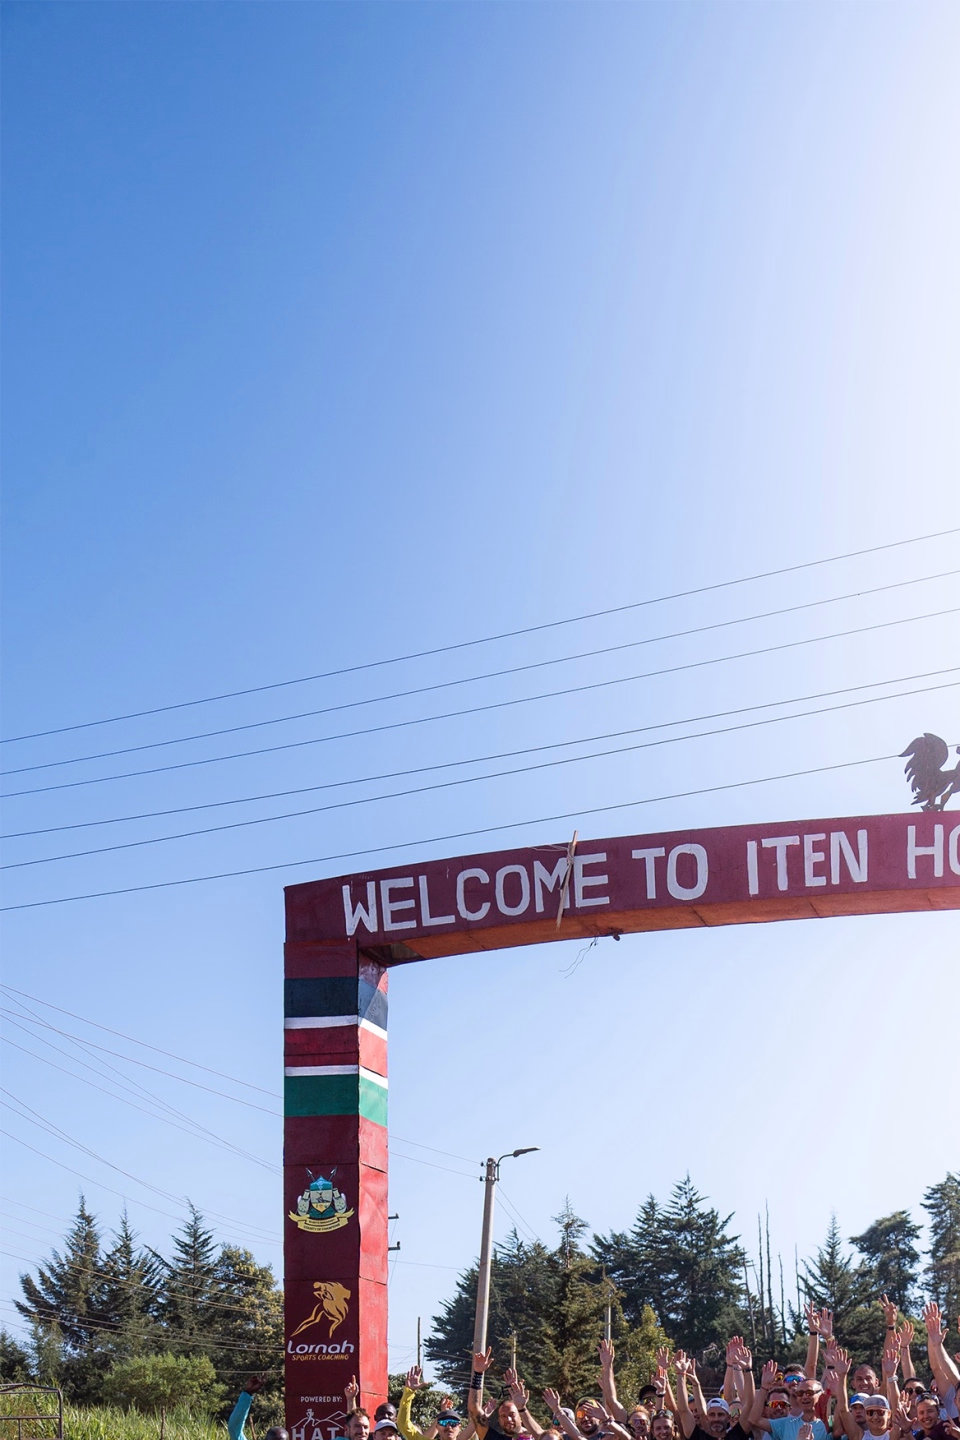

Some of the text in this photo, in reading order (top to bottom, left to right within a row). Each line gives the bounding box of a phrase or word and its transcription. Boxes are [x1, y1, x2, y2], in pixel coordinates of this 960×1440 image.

[342, 851, 610, 936] WELCOME
[632, 843, 709, 901] TO
[746, 829, 869, 896] ITEN
[287, 1340, 354, 1354] Lornah
